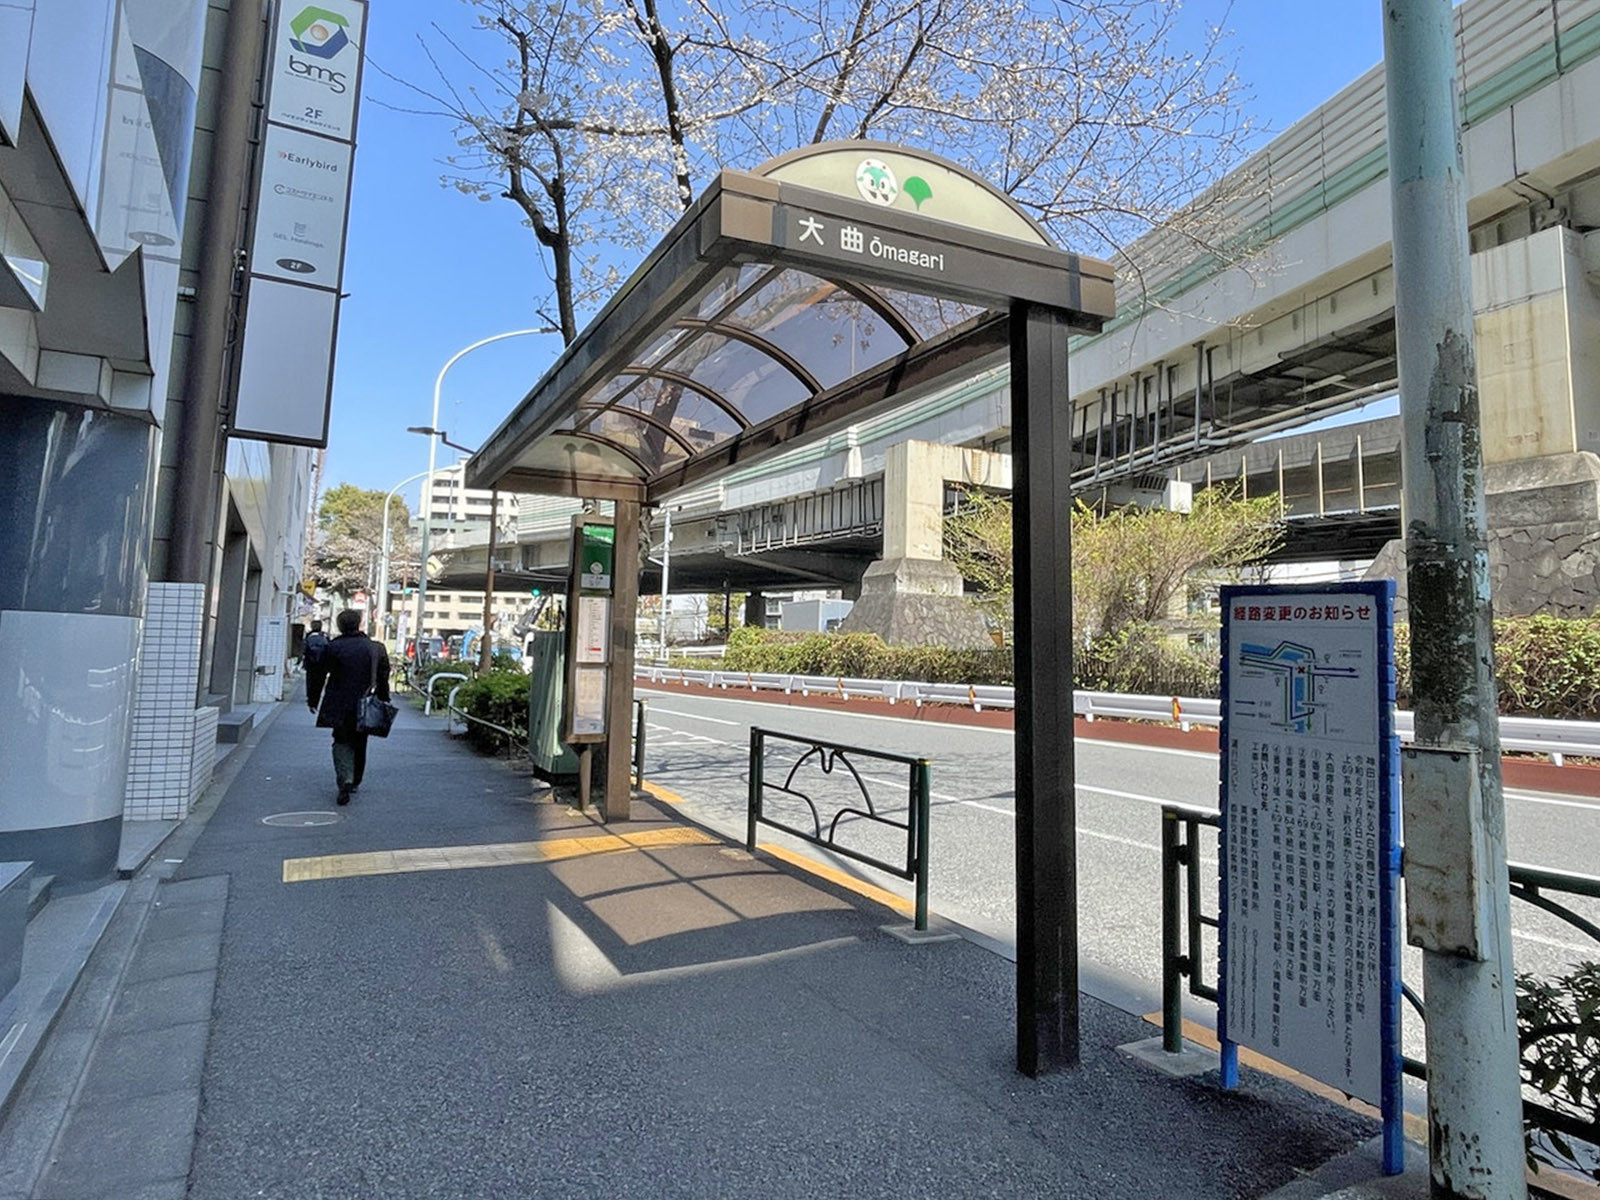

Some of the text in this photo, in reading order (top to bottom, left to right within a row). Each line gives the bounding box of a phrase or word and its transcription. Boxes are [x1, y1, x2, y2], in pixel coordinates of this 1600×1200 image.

[289, 55, 346, 93] bms
[305, 107, 323, 119] 2F
[288, 152, 337, 172] Earlybird
[798, 217, 945, 271] 大曲 Ōmagari
[290, 262, 302, 270] 2F
[1233, 605, 1371, 621] 経路変更のお知らせ
